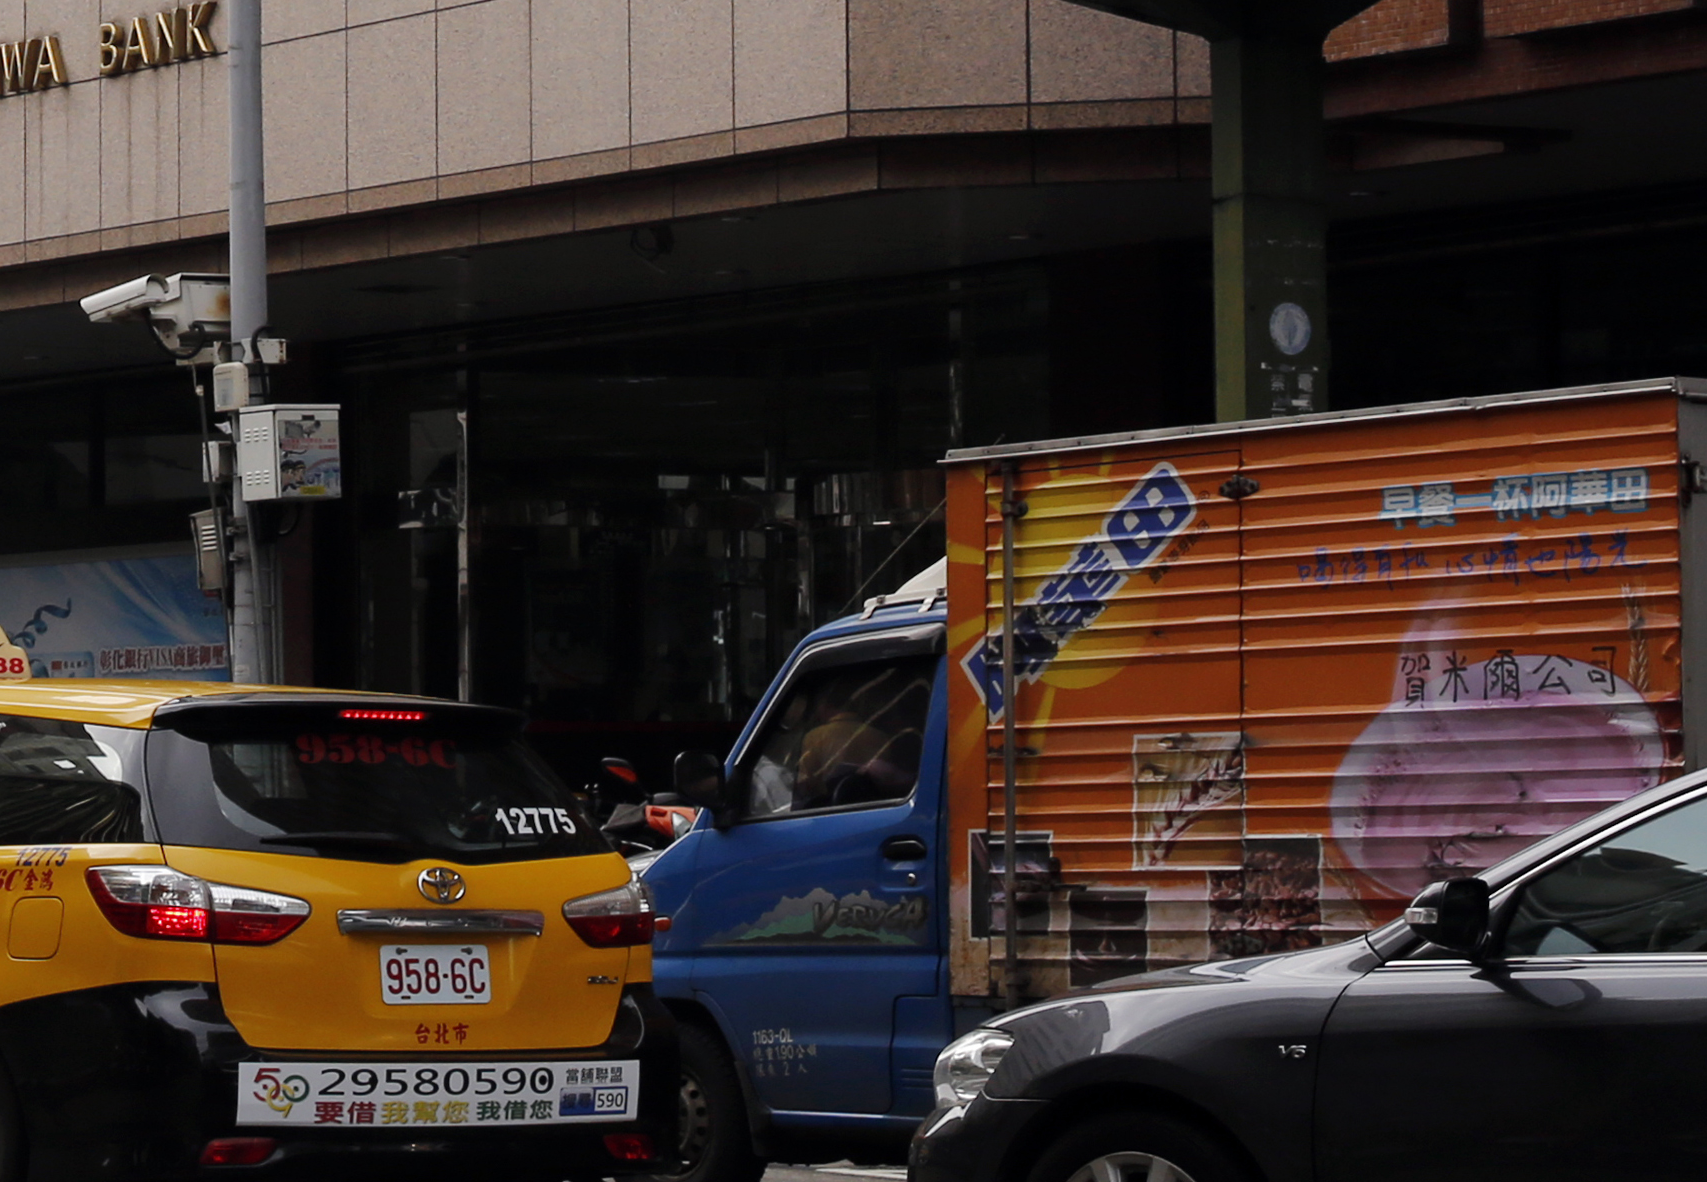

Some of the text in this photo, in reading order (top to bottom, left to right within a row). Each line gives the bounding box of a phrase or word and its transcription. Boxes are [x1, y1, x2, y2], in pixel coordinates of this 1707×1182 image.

[98, 0, 219, 76] BANK
[1382, 469, 1649, 529] 早餐一杯阿華田
[1401, 646, 1616, 708] 賀米爾公司
[296, 733, 459, 769] 958-6C
[495, 807, 576, 835] 12775
[15, 847, 72, 867] 12775
[386, 957, 486, 995] 958-6C
[414, 1023, 470, 1045] 台北市
[752, 1028, 794, 1044] 1163-QL
[317, 1067, 554, 1097] 29580590
[597, 1091, 624, 1110] 590
